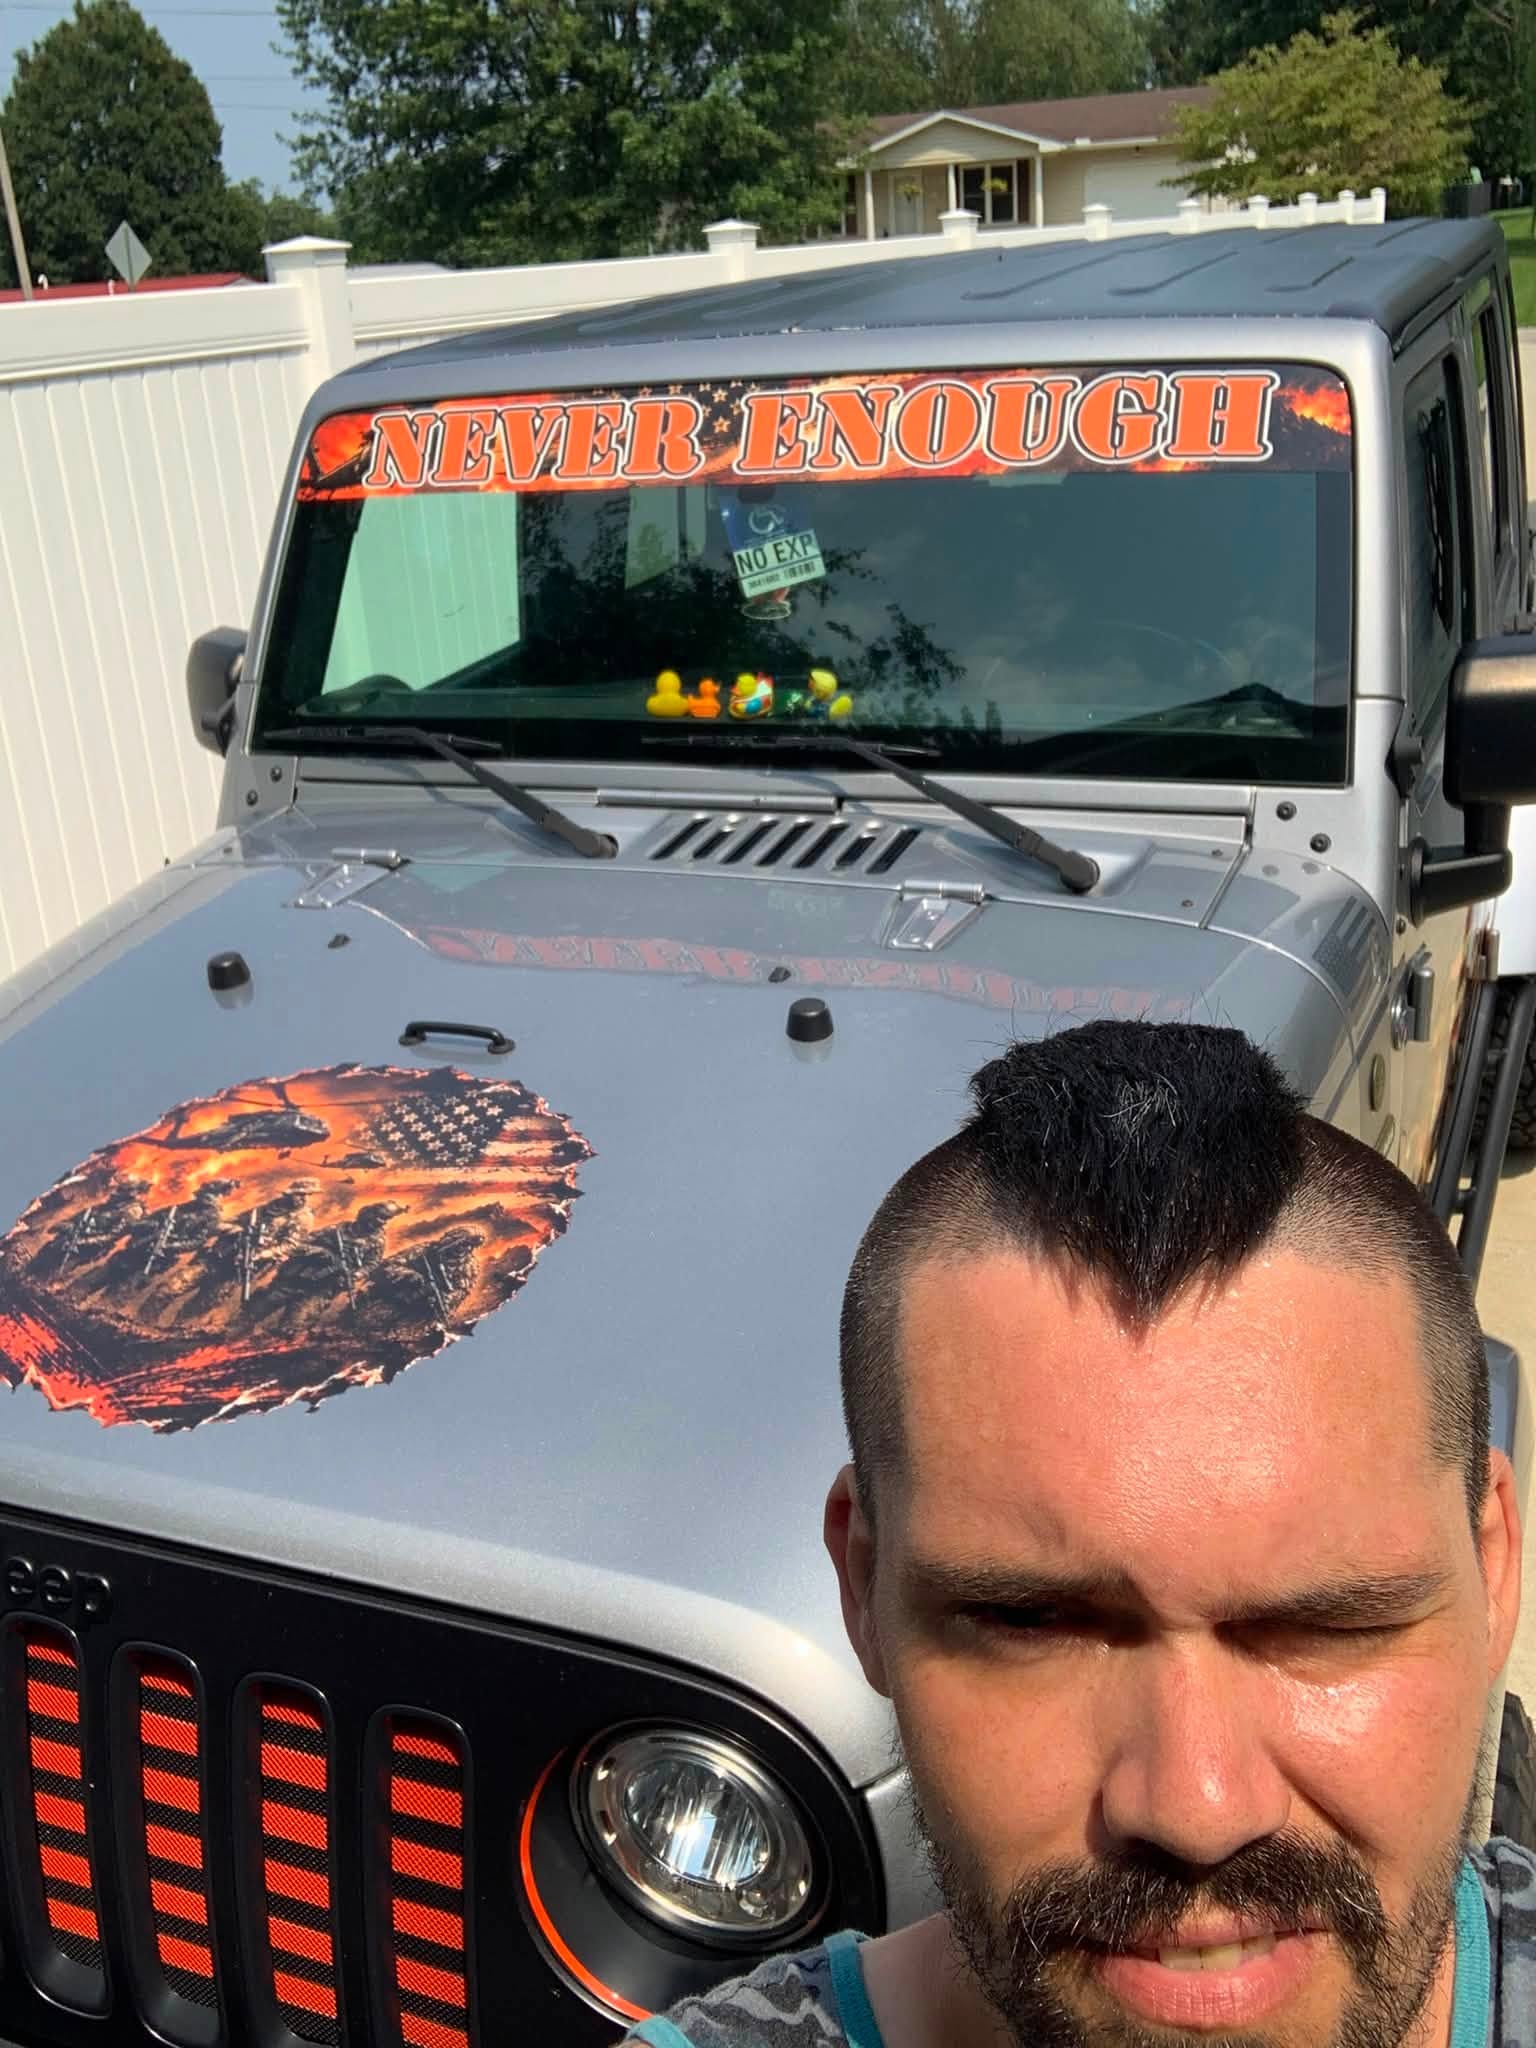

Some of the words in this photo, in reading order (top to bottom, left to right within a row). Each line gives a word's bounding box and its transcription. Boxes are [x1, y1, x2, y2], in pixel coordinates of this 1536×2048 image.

[362, 397, 704, 487] NEVER
[733, 369, 1279, 473] ENOUGH
[736, 547, 768, 575] NO
[772, 533, 813, 563] EXP
[6, 1555, 113, 1615] eep
